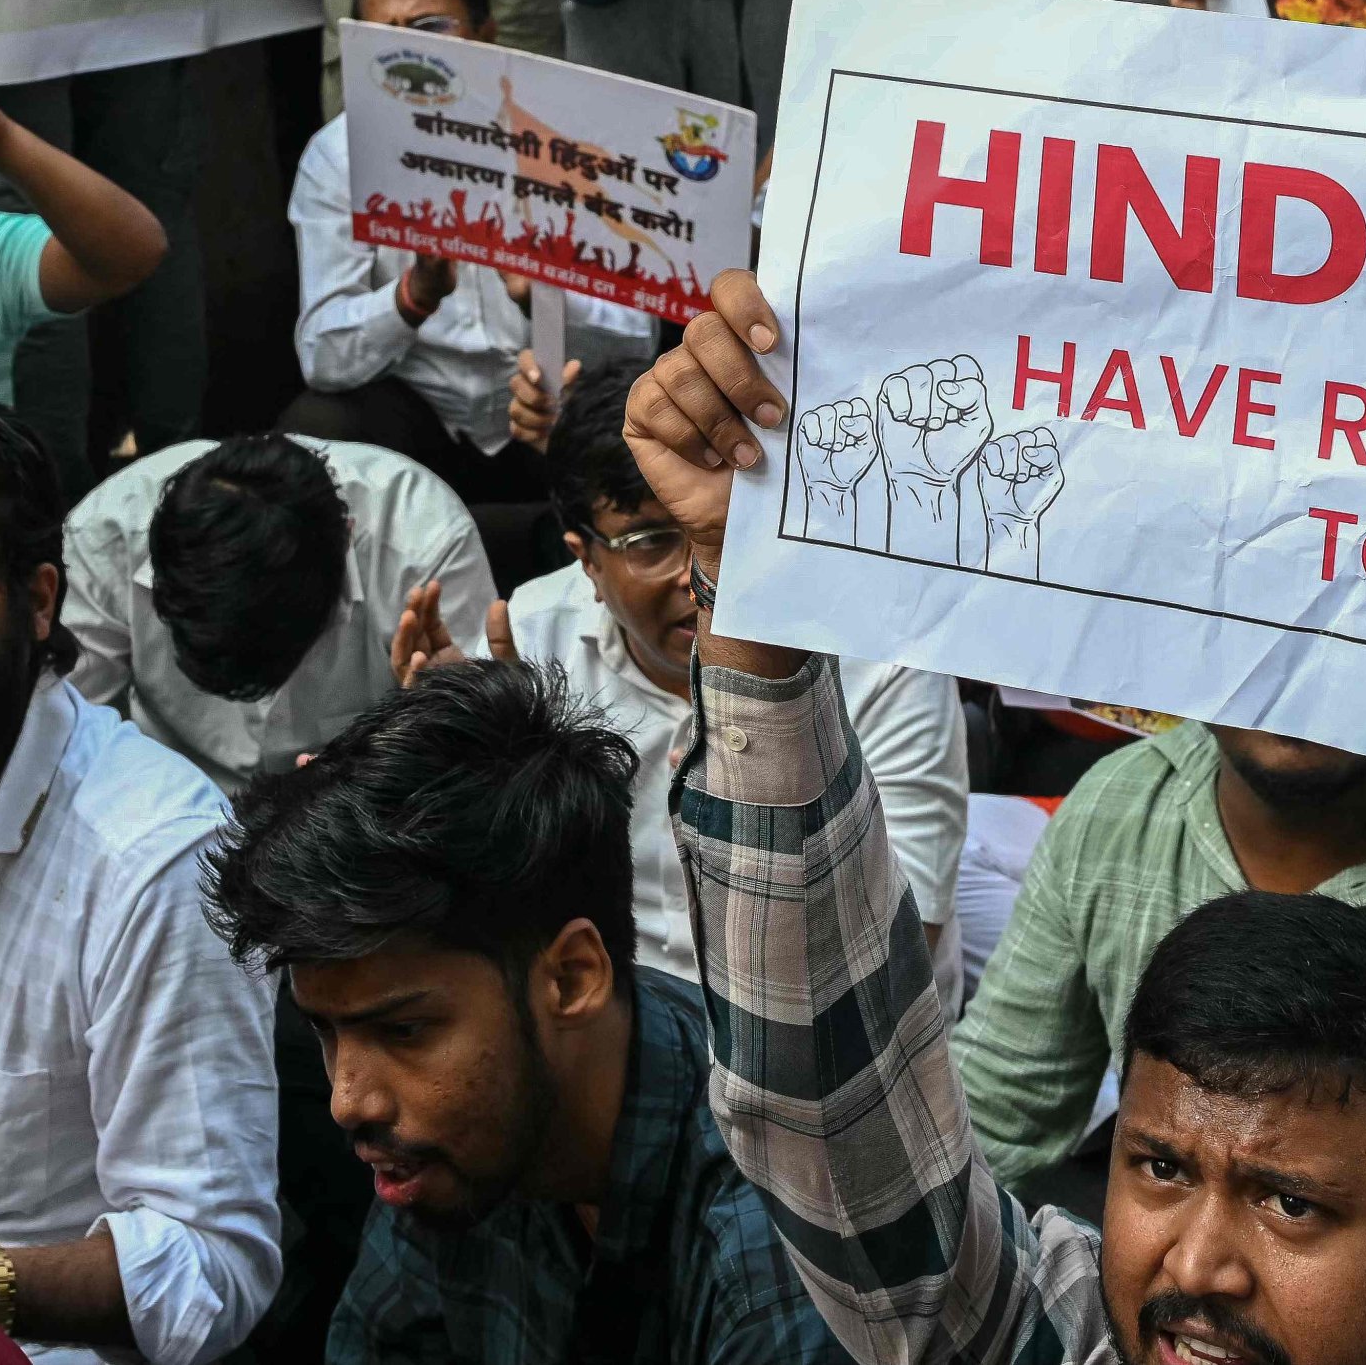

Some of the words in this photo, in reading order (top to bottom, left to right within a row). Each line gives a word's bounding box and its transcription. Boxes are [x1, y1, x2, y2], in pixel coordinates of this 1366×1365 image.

[399, 151, 504, 191] अकारण
[513, 175, 577, 211] हमले
[584, 190, 622, 224] बंद
[627, 204, 695, 244] करो!
[413, 110, 542, 160] बांग्लादेशी
[550, 136, 636, 187] हिंदुओं
[644, 165, 681, 197] पर
[1010, 335, 1282, 452] HAVE
